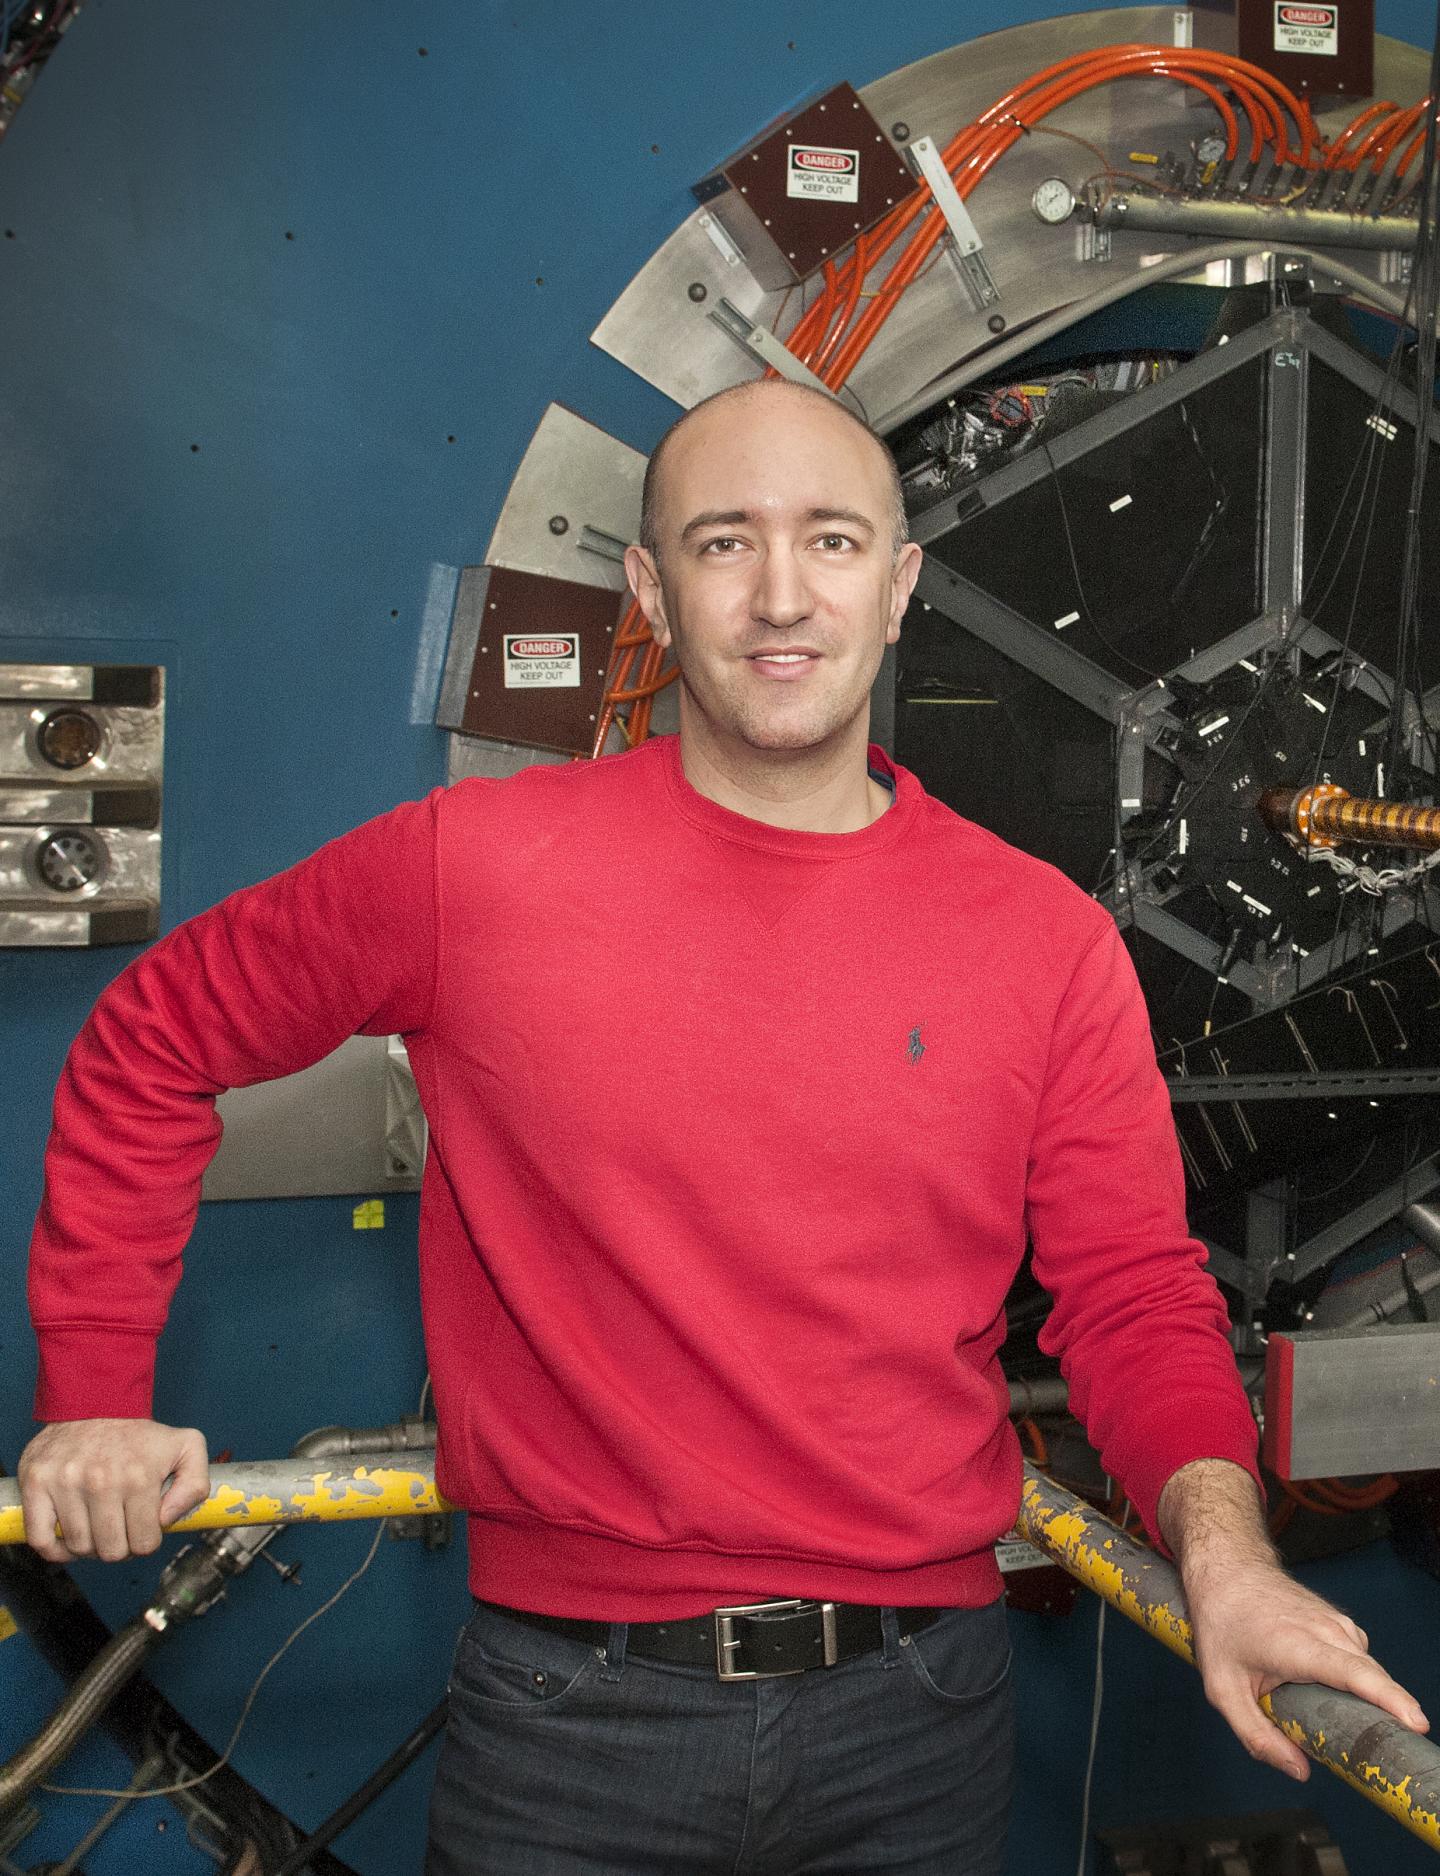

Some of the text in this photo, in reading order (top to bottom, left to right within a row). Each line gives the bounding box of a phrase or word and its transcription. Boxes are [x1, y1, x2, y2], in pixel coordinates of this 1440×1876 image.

[1280, 28, 1332, 38] HIGH VOLTAGE
[1288, 38, 1325, 47] KEEP OUT
[802, 154, 845, 168] DANGER
[794, 173, 852, 185] HIGH VOLTAGE
[802, 183, 844, 194] KEEP OUT
[519, 642, 564, 654] DANGER
[510, 661, 572, 670] HIGH VOLTAGE
[520, 671, 563, 680] KEEP OUT
